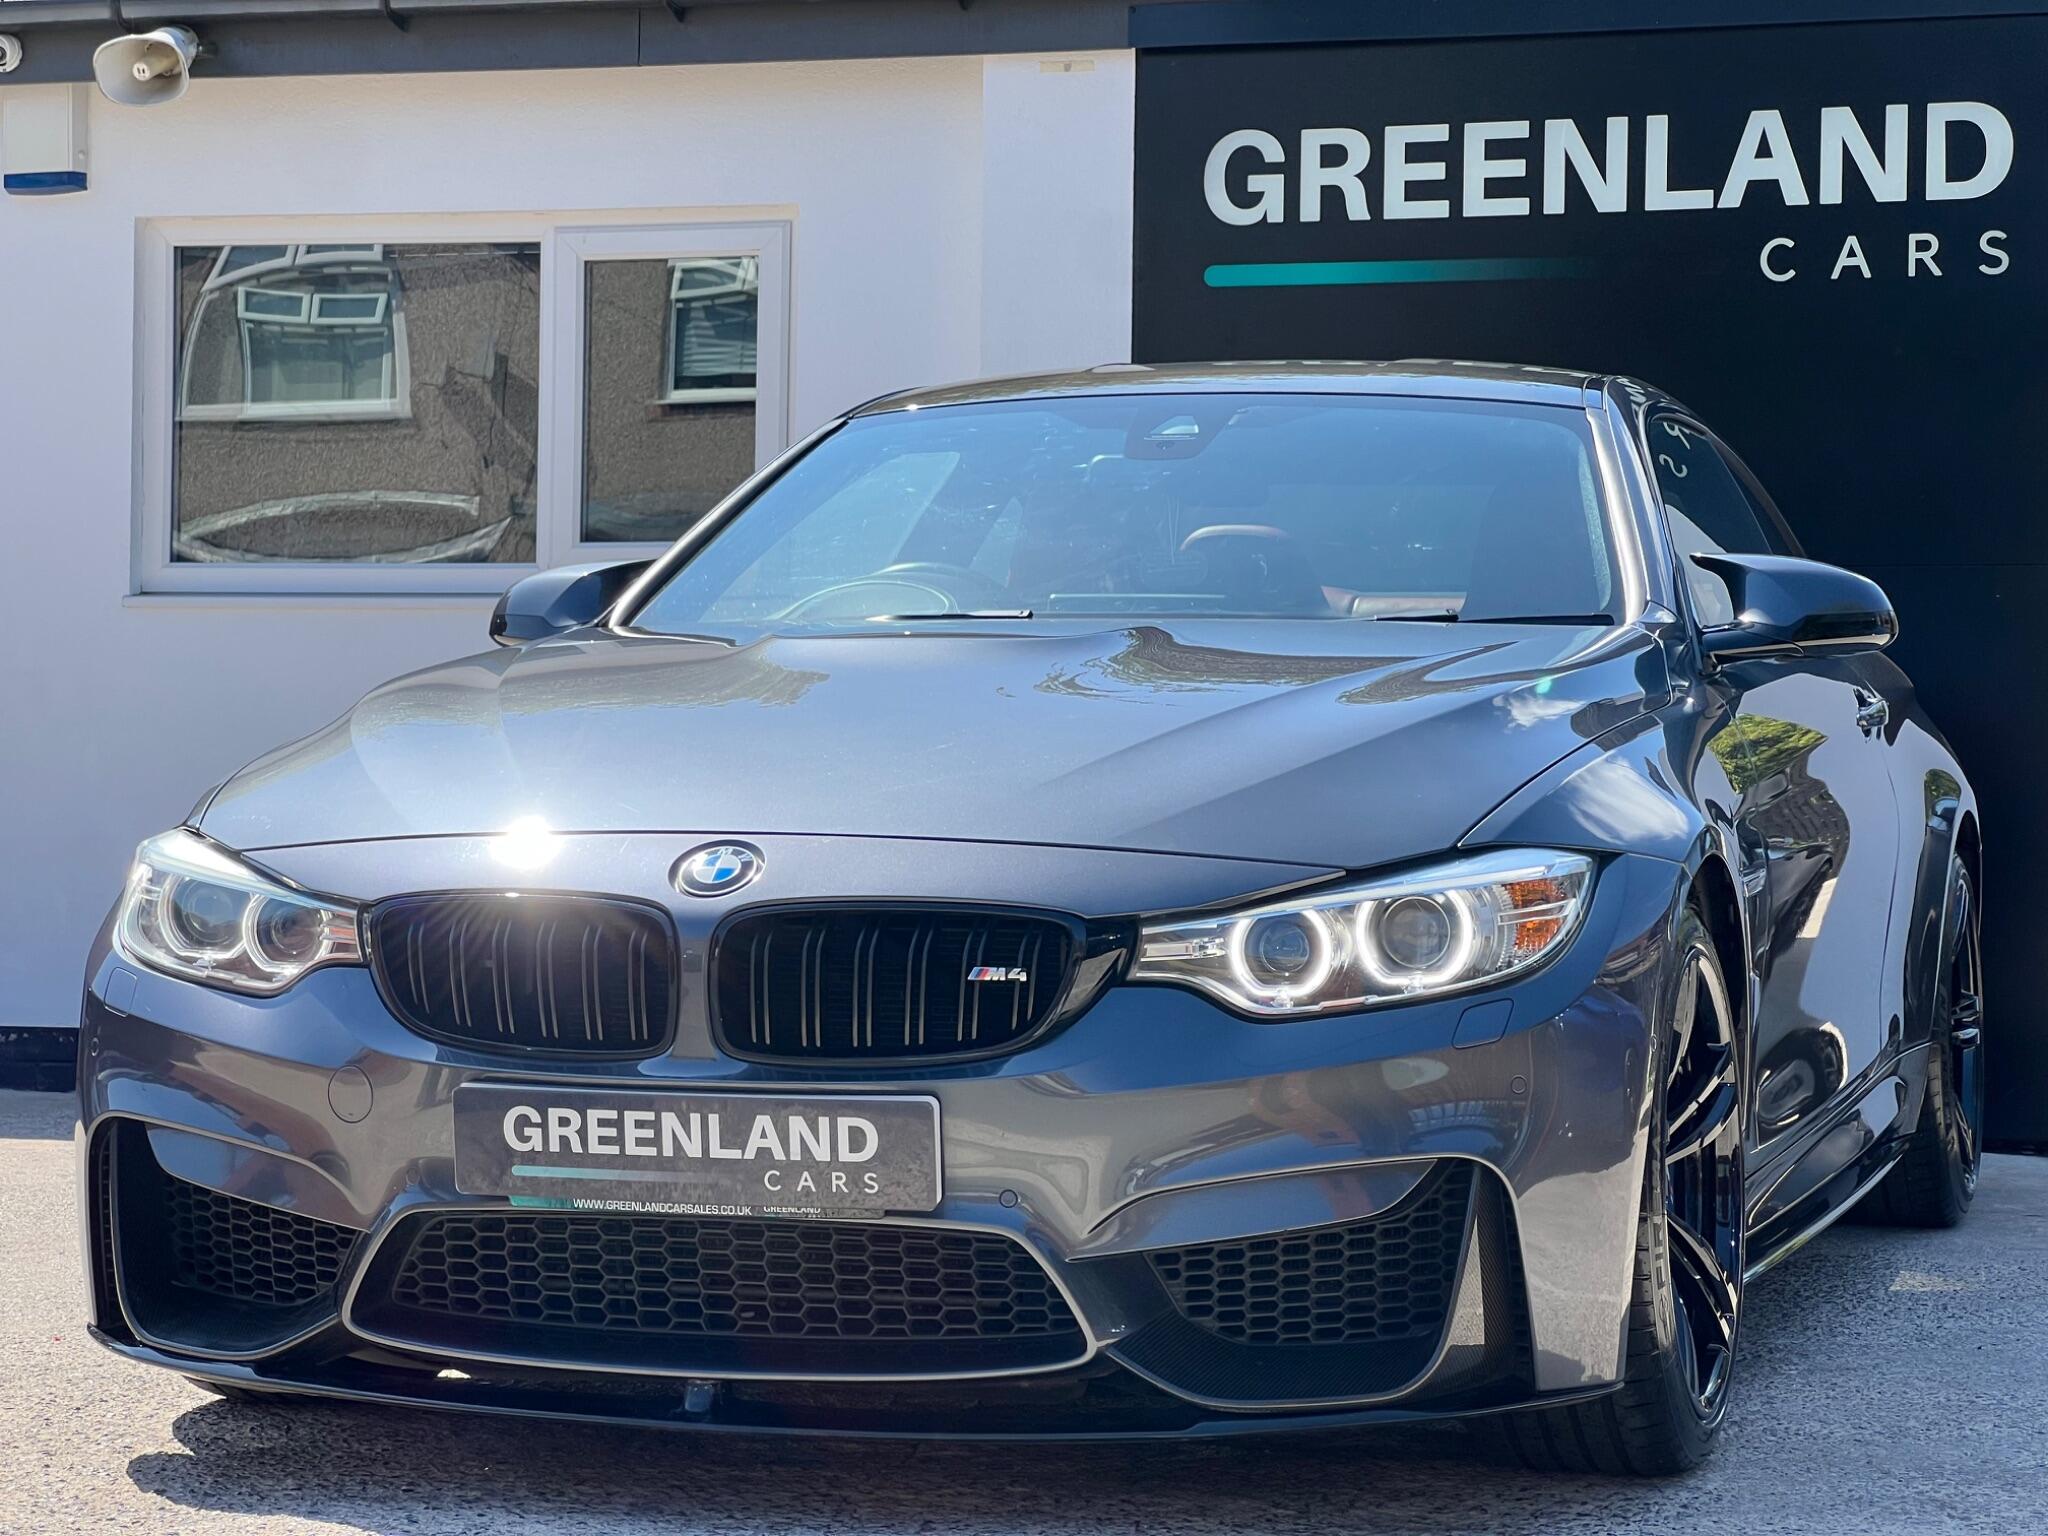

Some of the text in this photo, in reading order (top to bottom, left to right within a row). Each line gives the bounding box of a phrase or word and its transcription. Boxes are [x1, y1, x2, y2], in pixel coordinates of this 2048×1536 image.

[1203, 101, 2014, 226] GREENLAND
[1759, 230, 2010, 282] CARS
[983, 967, 1027, 981] M4
[503, 1105, 879, 1163] GREENLAND
[763, 1169, 879, 1194] CARS
[573, 1198, 752, 1216] WWW.GREENLANDCARSALES.CO.UK
